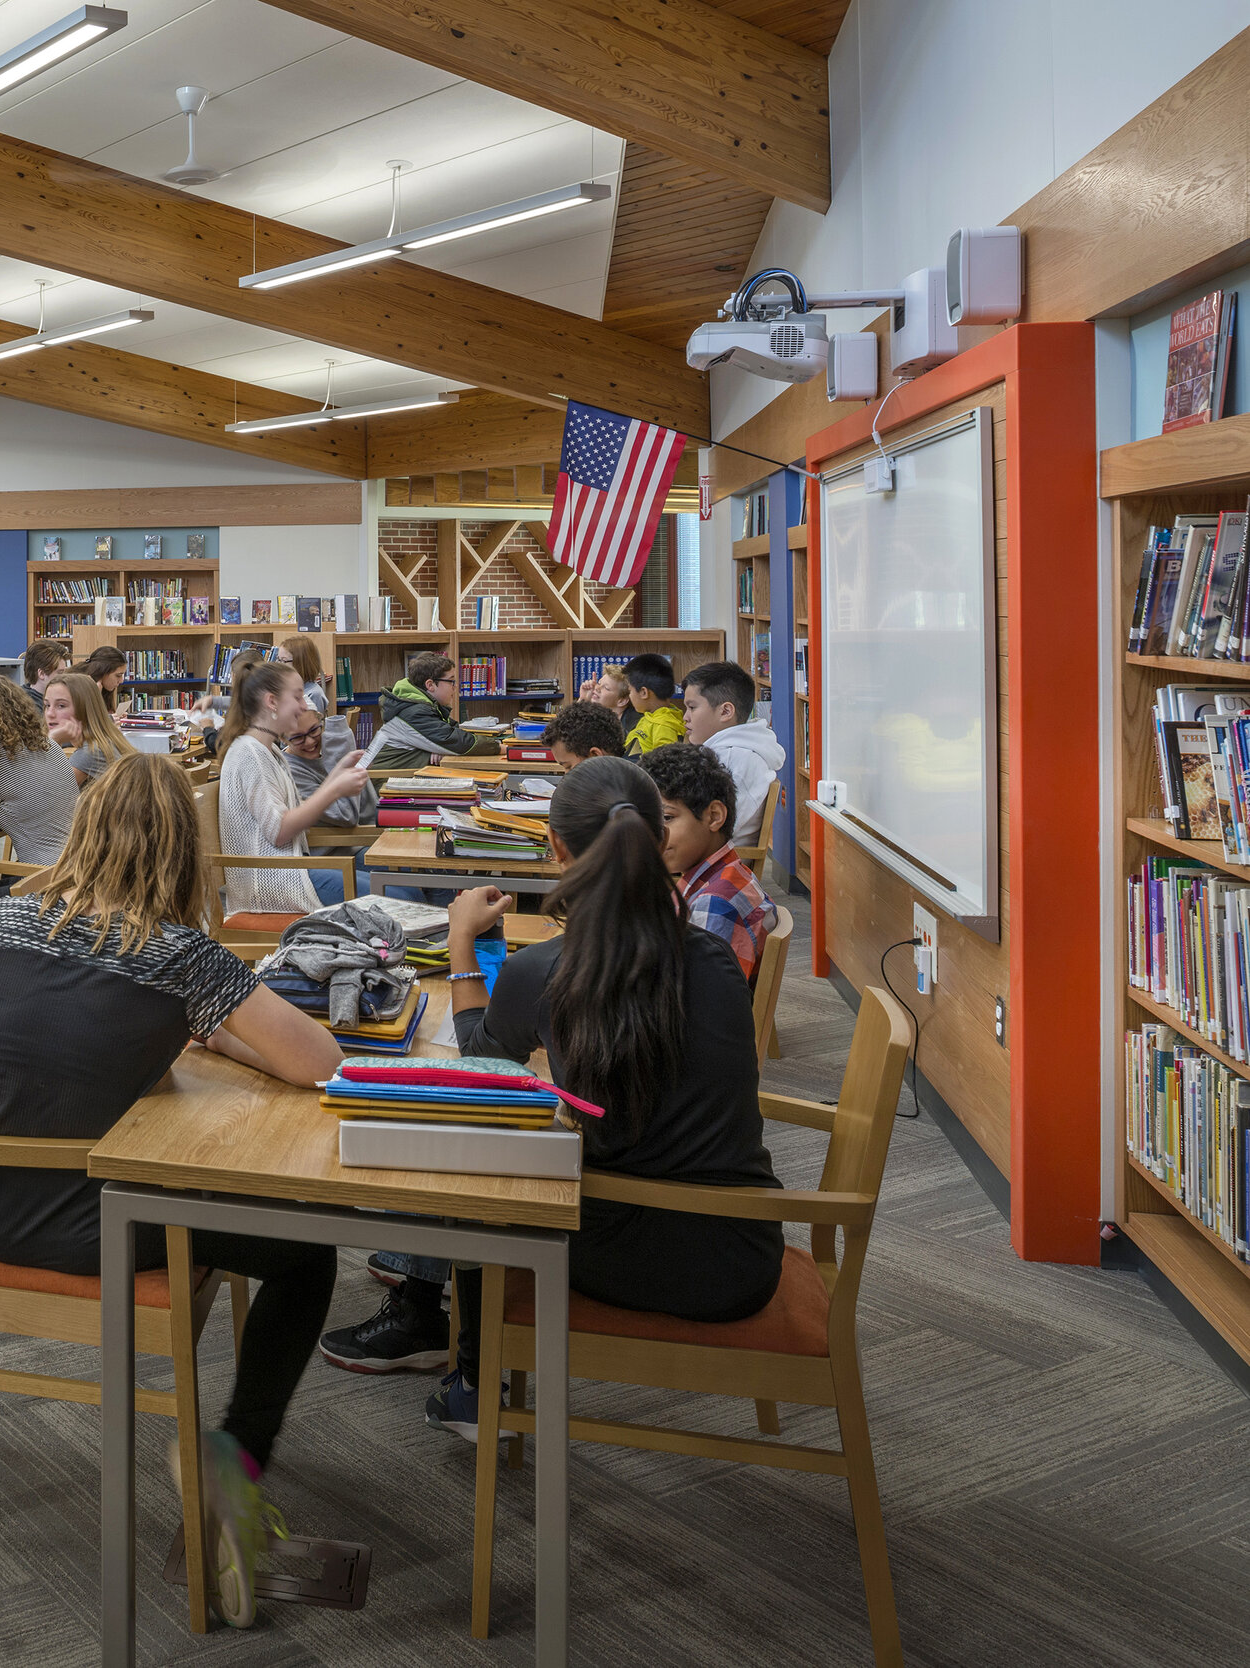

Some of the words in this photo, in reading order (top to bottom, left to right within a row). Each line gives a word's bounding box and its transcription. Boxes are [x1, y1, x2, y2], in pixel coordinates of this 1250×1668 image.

[1173, 307, 1196, 330] WHAT
[1195, 299, 1213, 321] THE
[1169, 325, 1195, 348] WORLD
[1195, 315, 1215, 338] EATS
[1181, 734, 1208, 743] THE
